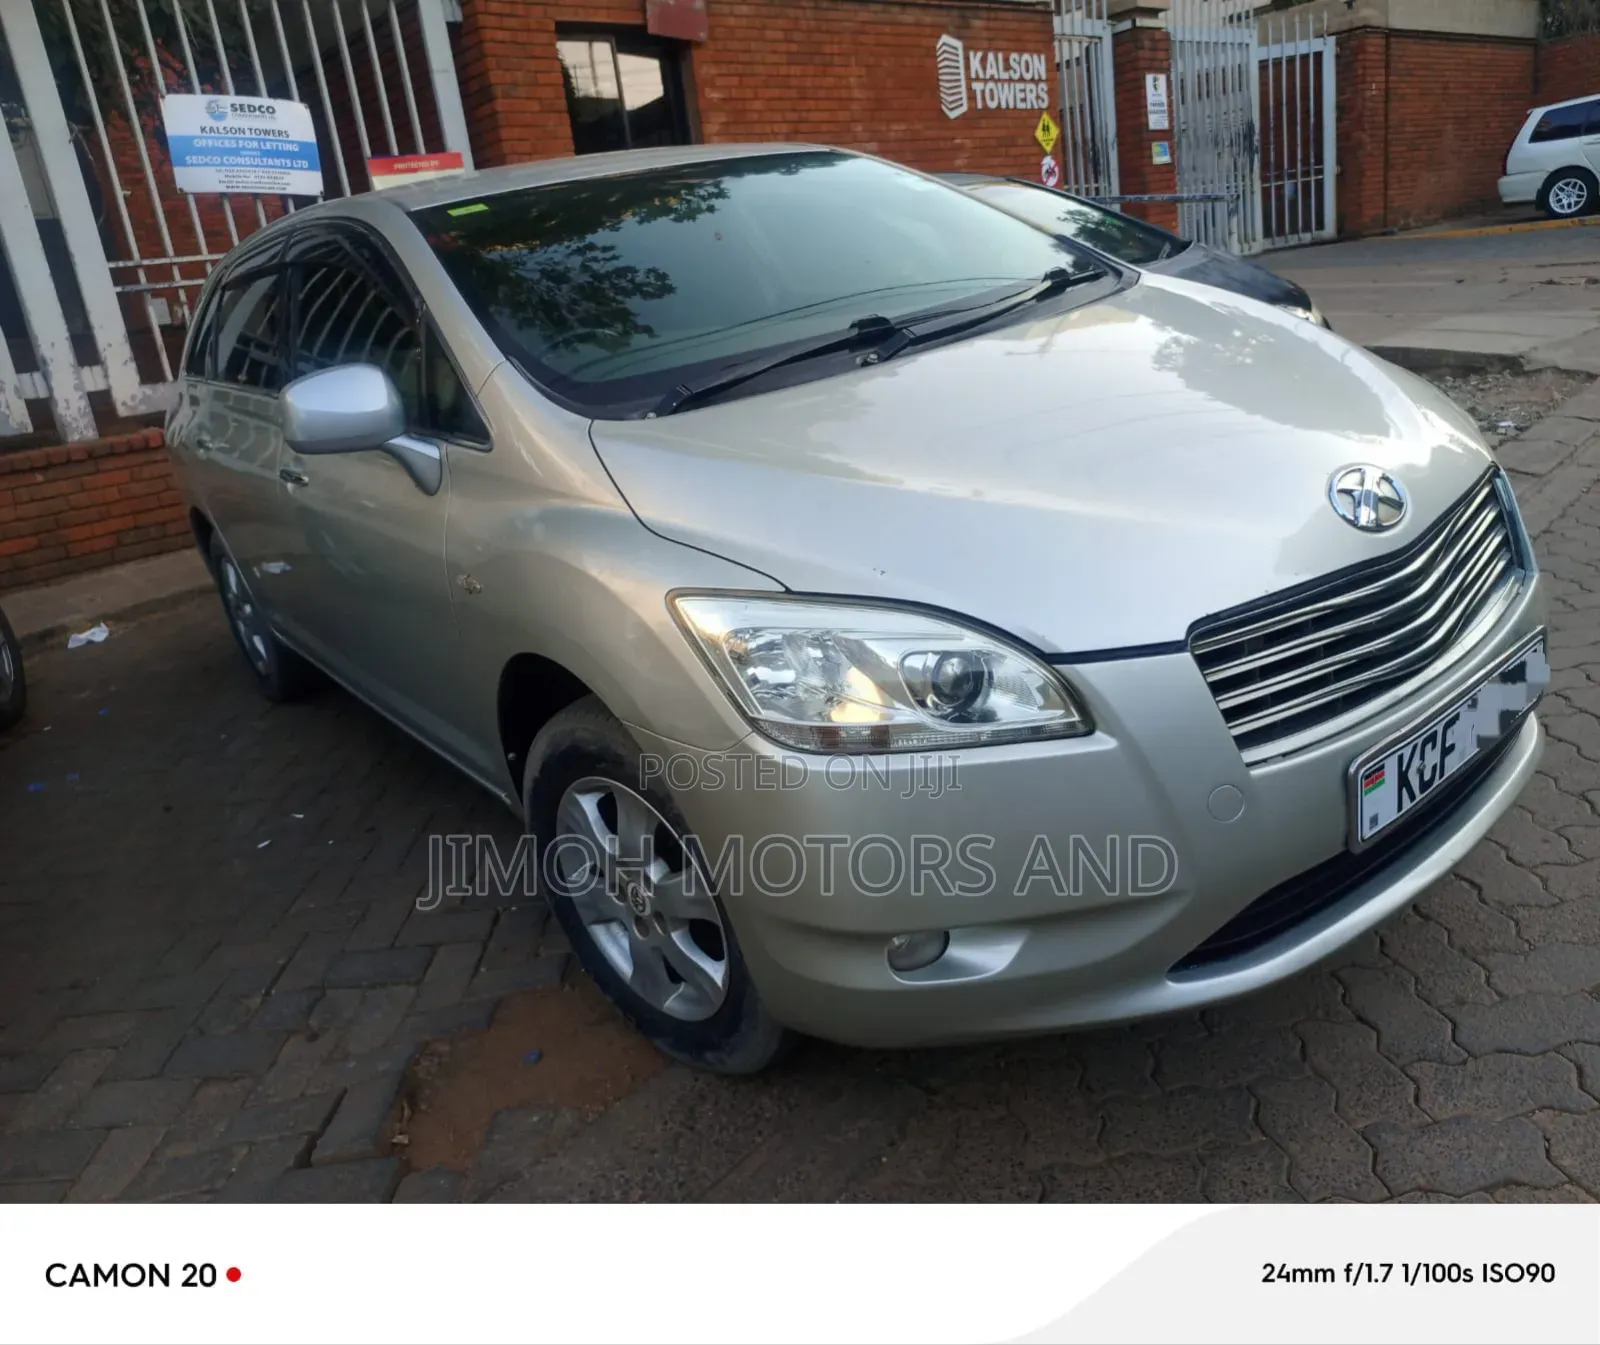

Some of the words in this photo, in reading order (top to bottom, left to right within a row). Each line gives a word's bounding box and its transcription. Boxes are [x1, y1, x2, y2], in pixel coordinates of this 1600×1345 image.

[969, 50, 1047, 80] KALSON
[971, 81, 1049, 110] TOWERS
[230, 103, 276, 114] SEDCO
[200, 125, 246, 136] KALSON
[247, 127, 290, 138] TOWERS
[193, 138, 237, 149] OFFICES
[238, 140, 260, 149] FOR
[260, 141, 299, 152] LETTING
[185, 154, 221, 165] SEDCO
[223, 155, 291, 168] CONSULTANTS
[292, 159, 309, 169] LTD
